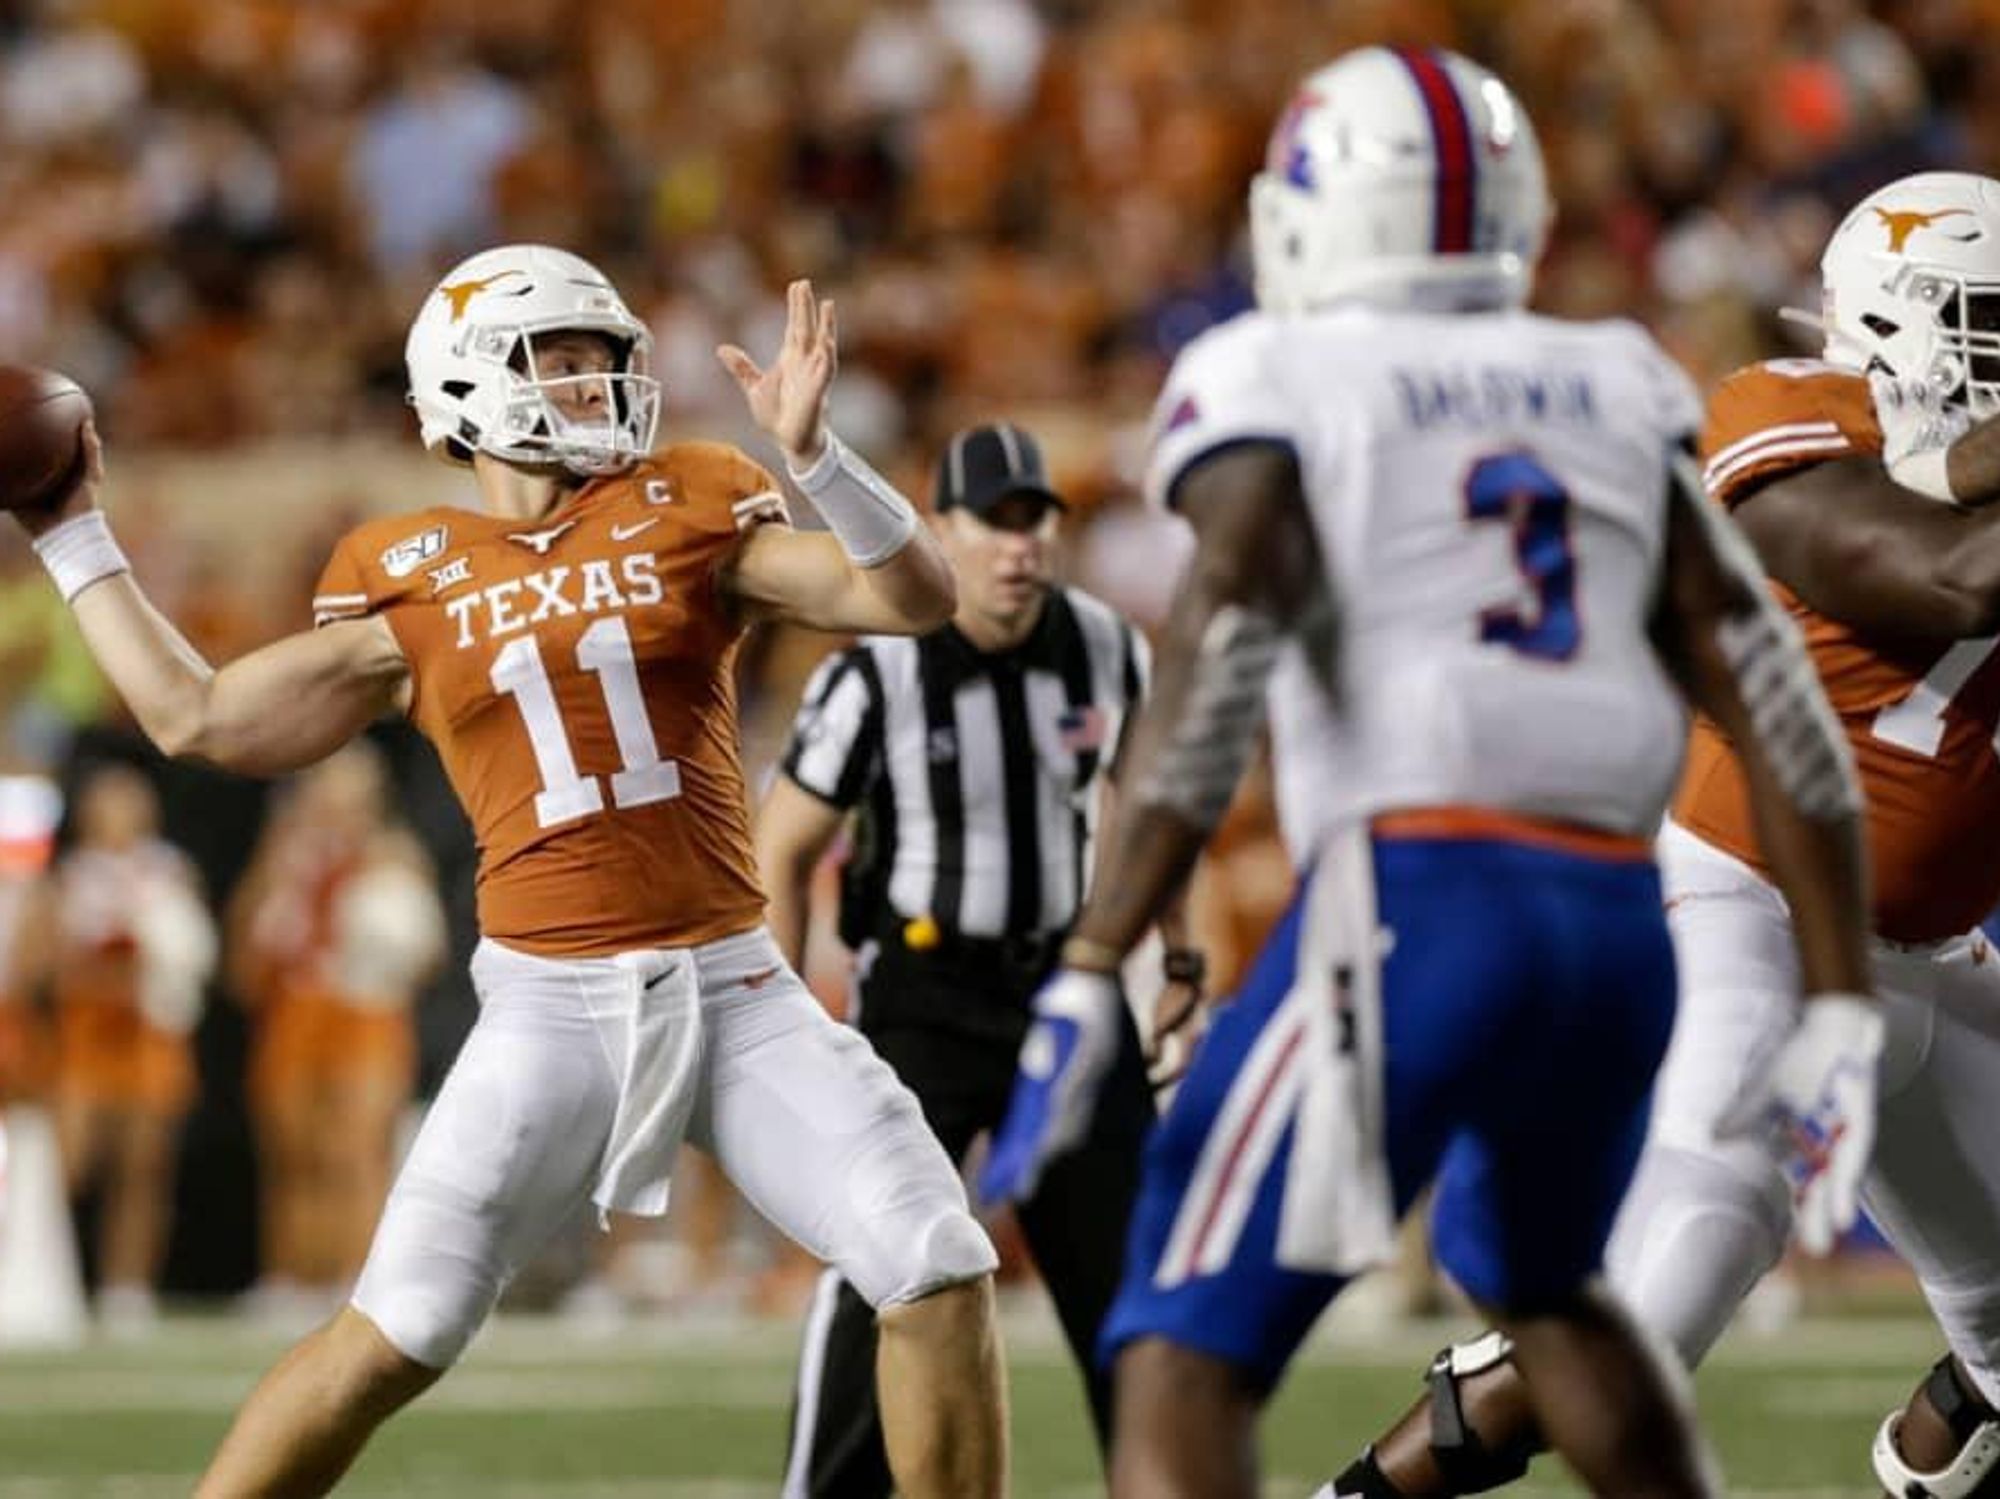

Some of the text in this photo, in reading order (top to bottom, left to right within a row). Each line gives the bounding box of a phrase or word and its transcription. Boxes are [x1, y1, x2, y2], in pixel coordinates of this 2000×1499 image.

[646, 478, 671, 504] C
[1463, 445, 1580, 664] 3
[446, 554, 663, 648] TEXAS
[490, 615, 681, 828] 11
